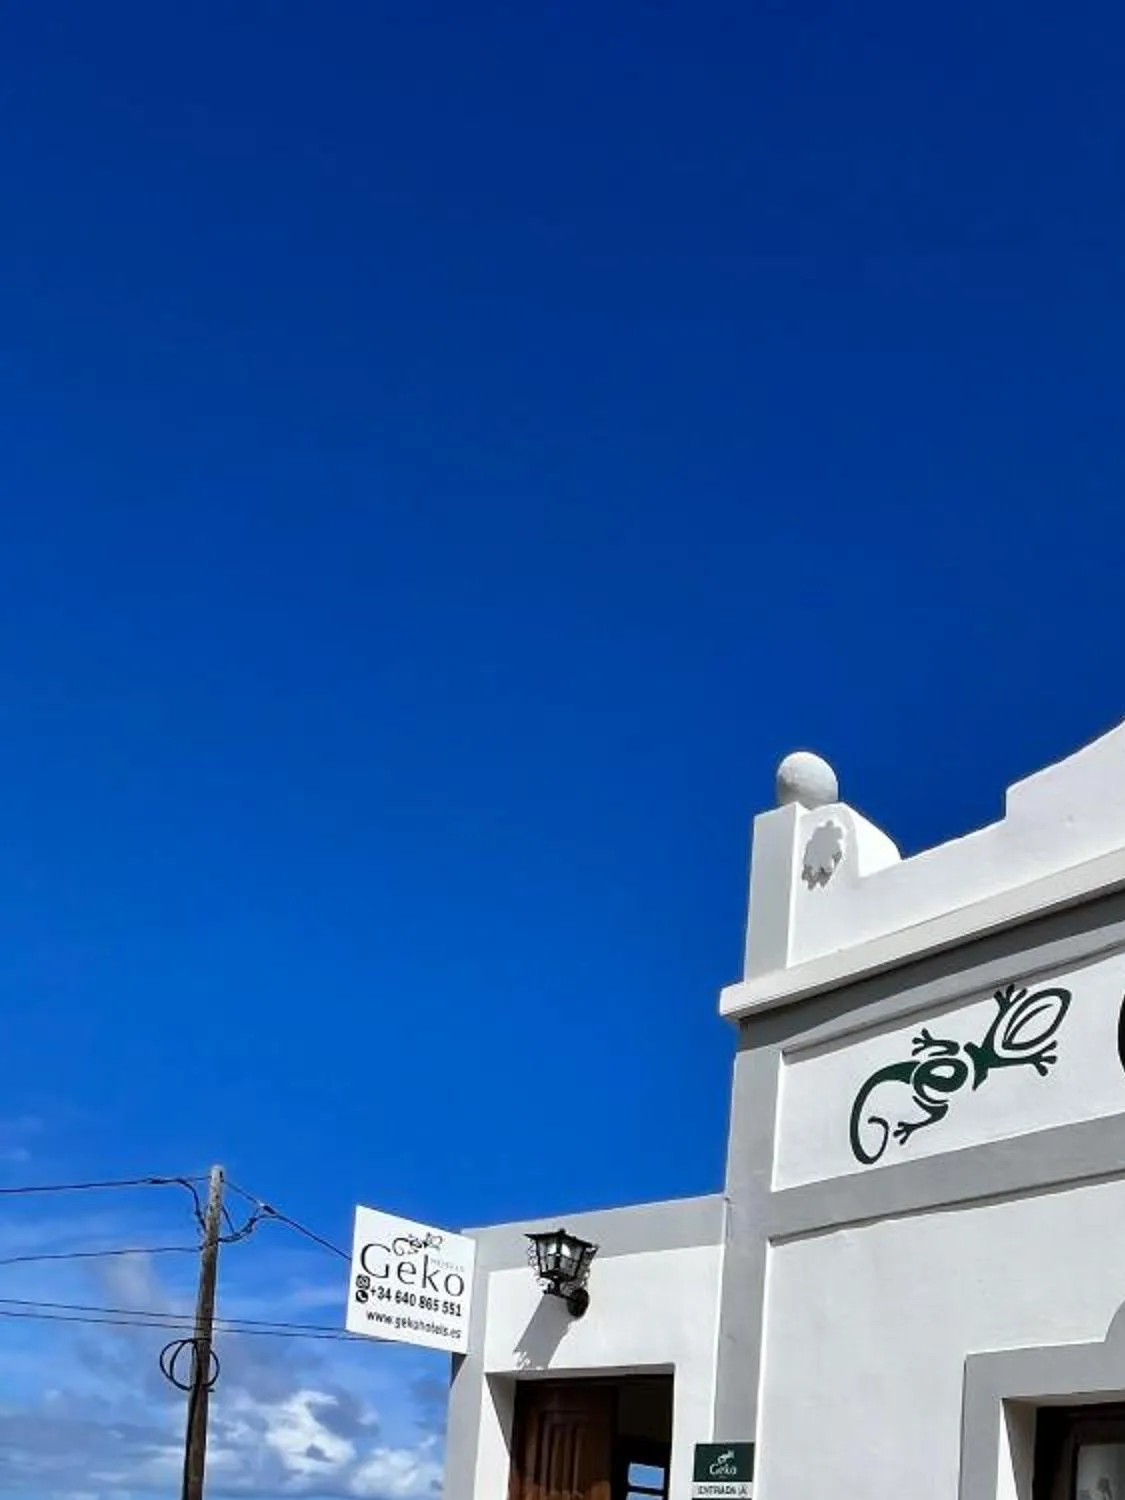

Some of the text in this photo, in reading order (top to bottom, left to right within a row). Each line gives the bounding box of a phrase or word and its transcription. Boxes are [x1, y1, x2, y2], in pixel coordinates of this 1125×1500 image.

[360, 1243, 465, 1297] Geko
[370, 1285, 462, 1317] +34 640 865 551
